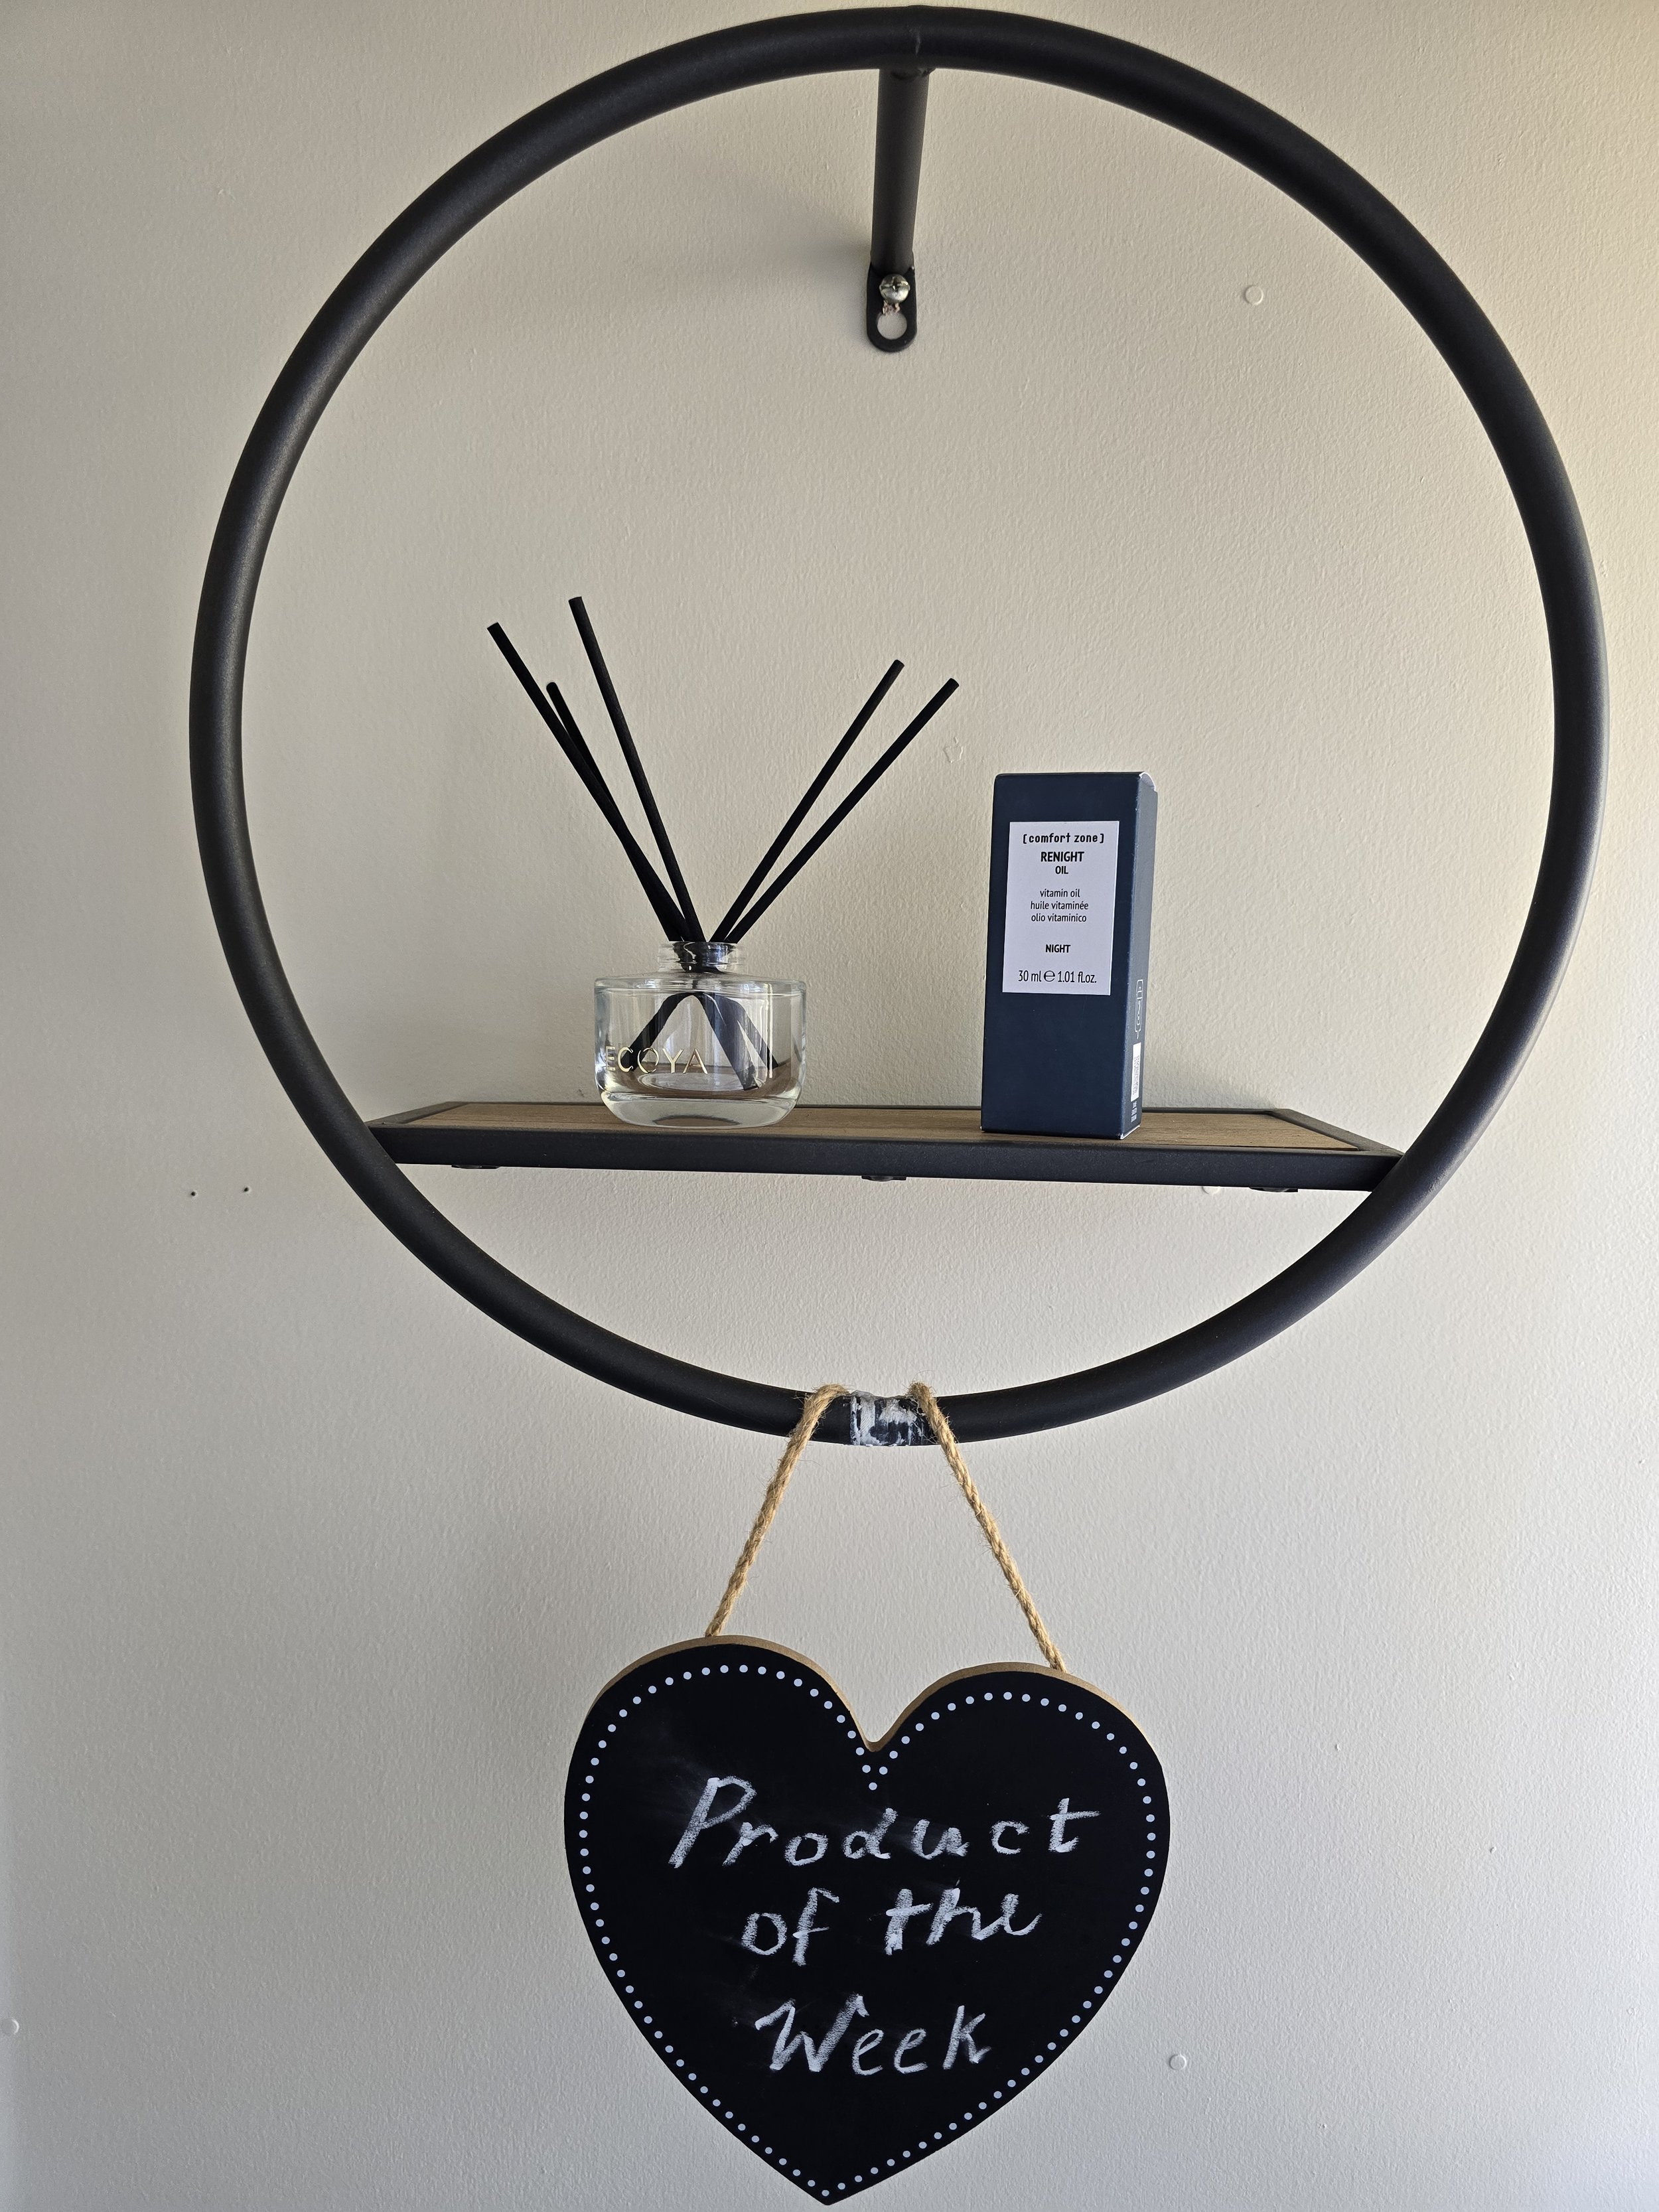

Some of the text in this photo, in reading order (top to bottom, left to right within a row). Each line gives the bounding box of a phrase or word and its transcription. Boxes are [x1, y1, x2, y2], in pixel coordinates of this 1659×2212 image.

[1041, 851, 1084, 862] RENIGHT
[1055, 865, 1068, 875] OIL
[1040, 889, 1080, 897] vitamin oil
[1031, 901, 1088, 910] huile vitaminée
[1031, 913, 1087, 922] olio vitaminico
[1045, 944, 1070, 953] NIGHT
[1018, 970, 1029, 982] 30
[1031, 970, 1042, 982] ml
[1058, 971, 1075, 983] 1.01
[1078, 971, 1097, 984] fl.oz.
[605, 1045, 708, 1074] ECOYA
[668, 1775, 1100, 1868] Product
[741, 1886, 1043, 1966] of the
[754, 1994, 991, 2075] Week
